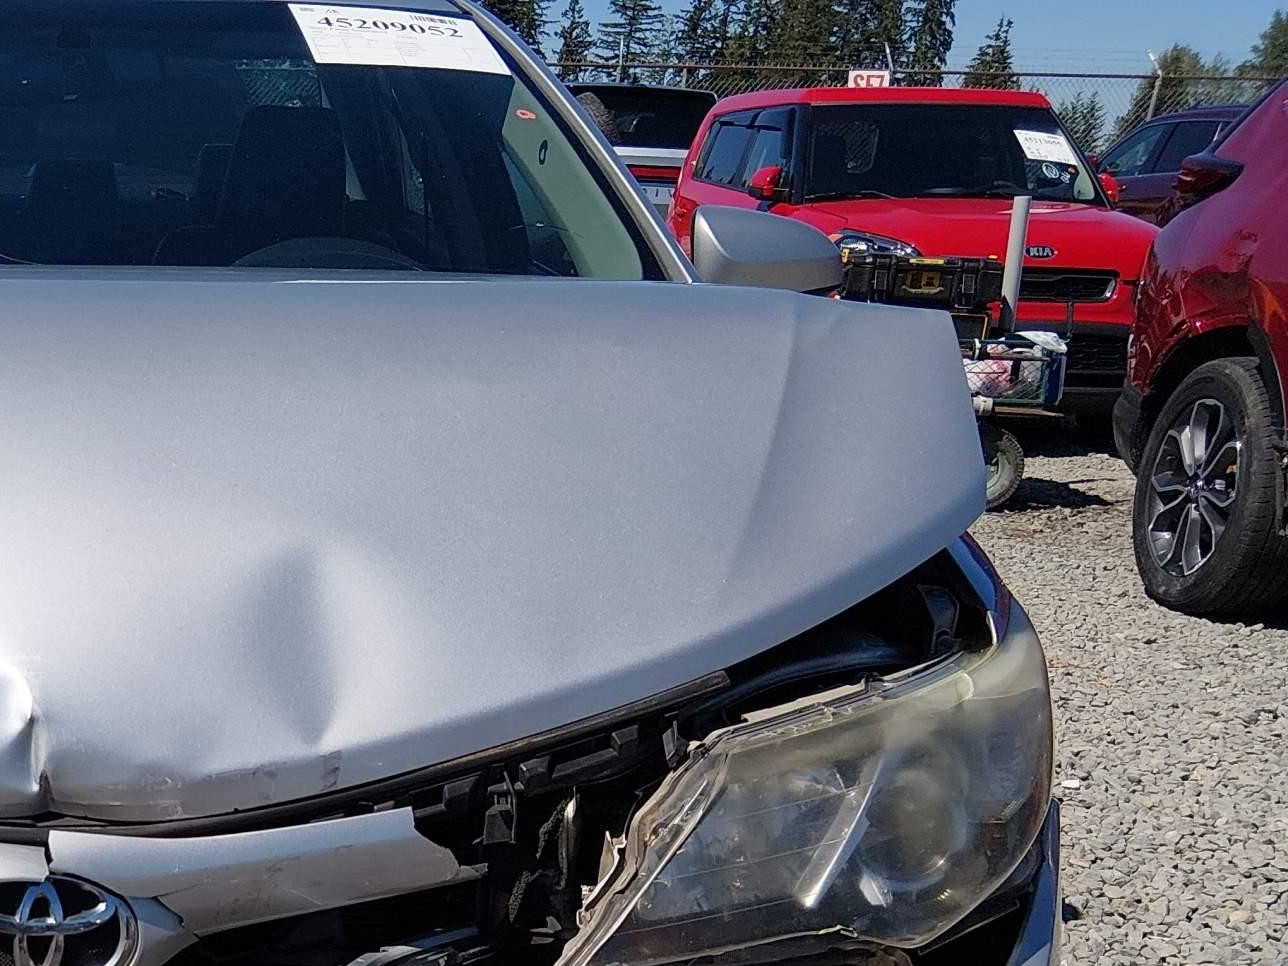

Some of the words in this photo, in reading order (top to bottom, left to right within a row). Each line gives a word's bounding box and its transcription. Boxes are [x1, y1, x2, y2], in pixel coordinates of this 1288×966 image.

[317, 16, 463, 38] 45209052
[853, 74, 885, 88] SF7
[1029, 247, 1053, 256] KIA
